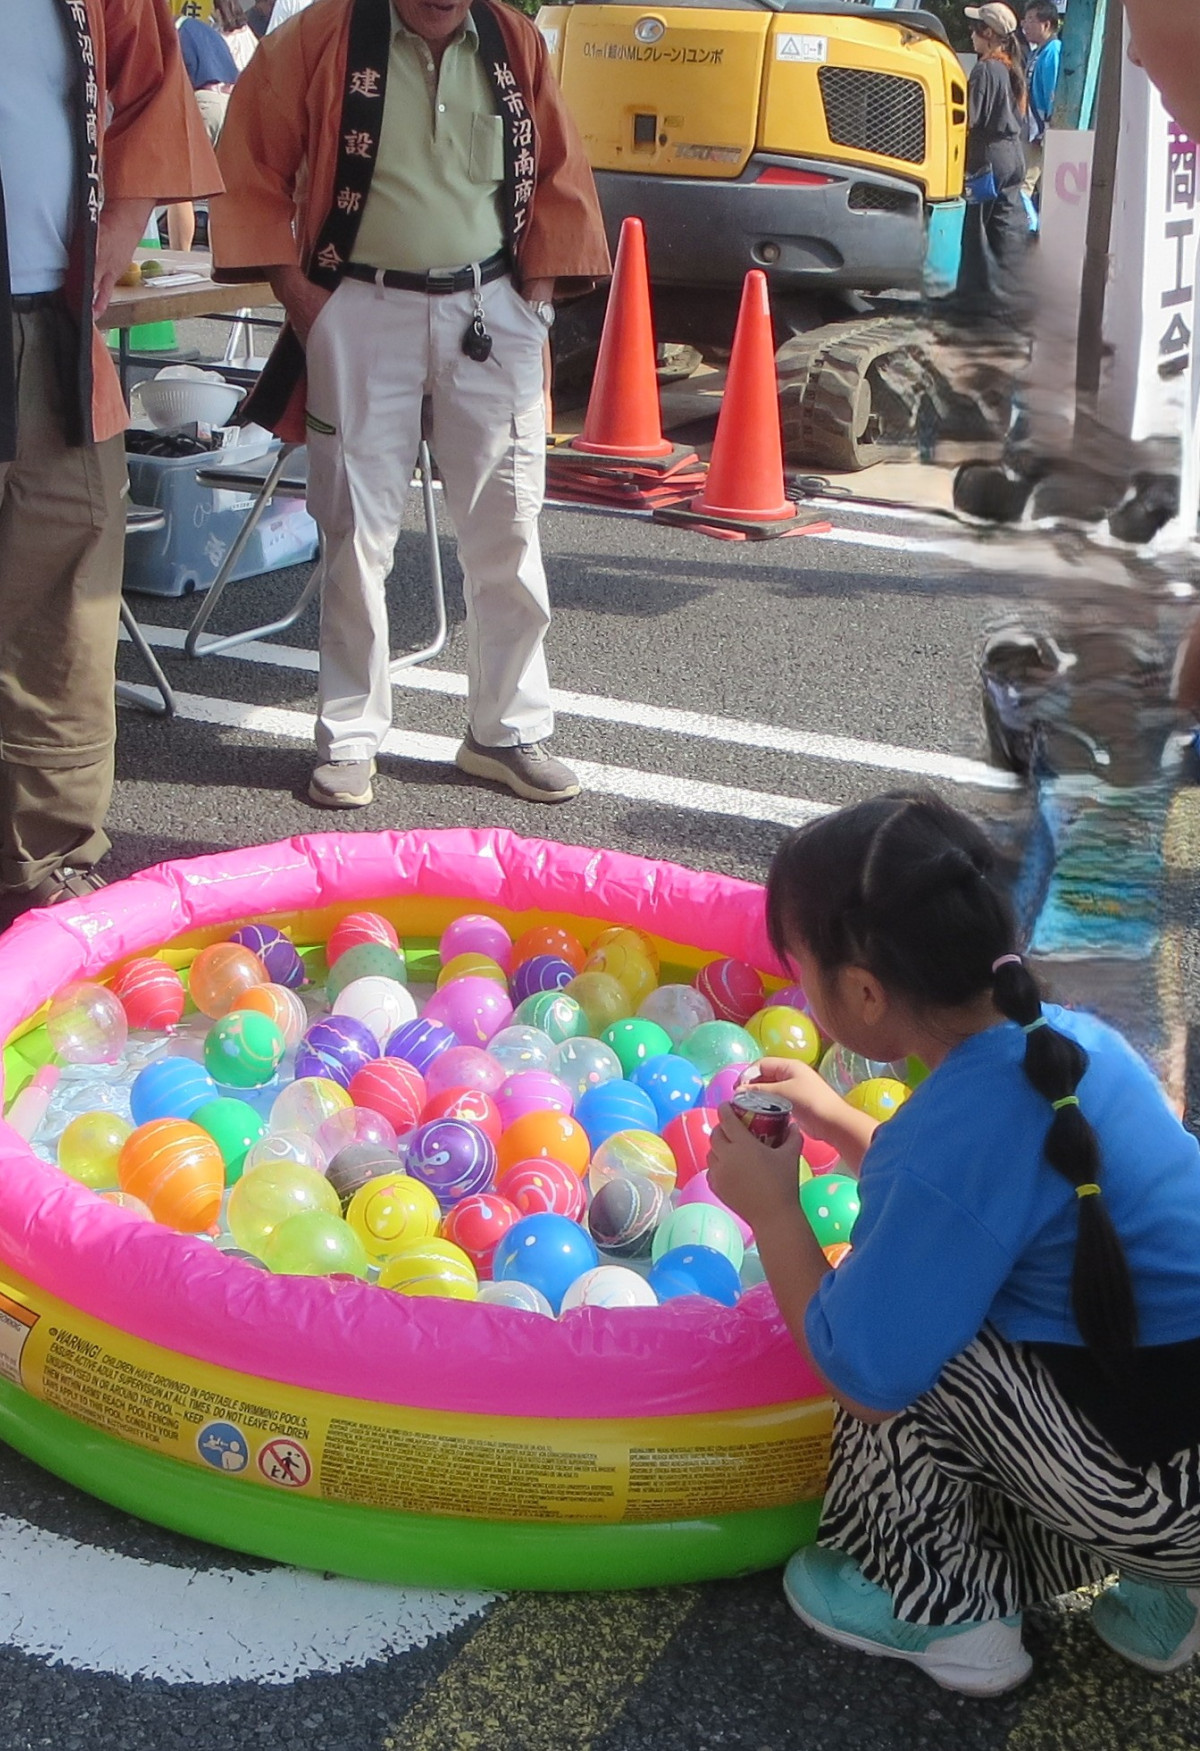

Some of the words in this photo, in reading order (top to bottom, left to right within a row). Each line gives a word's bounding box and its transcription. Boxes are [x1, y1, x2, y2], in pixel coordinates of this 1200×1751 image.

[317, 67, 381, 271] 建設部会
[493, 62, 536, 257] 柏市沼南商工
[56, 1329, 102, 1359] WARNING!
[102, 1354, 134, 1374] CHILDREN
[153, 1374, 190, 1394] DROWNED
[200, 1389, 239, 1411] PORTABLE
[239, 1401, 279, 1421] SWIMMING
[184, 1411, 204, 1425] KEEP
[213, 1406, 226, 1418] DO
[226, 1410, 243, 1424] NOT
[243, 1414, 269, 1431] LEAVE
[269, 1421, 309, 1440] CHILDREN
